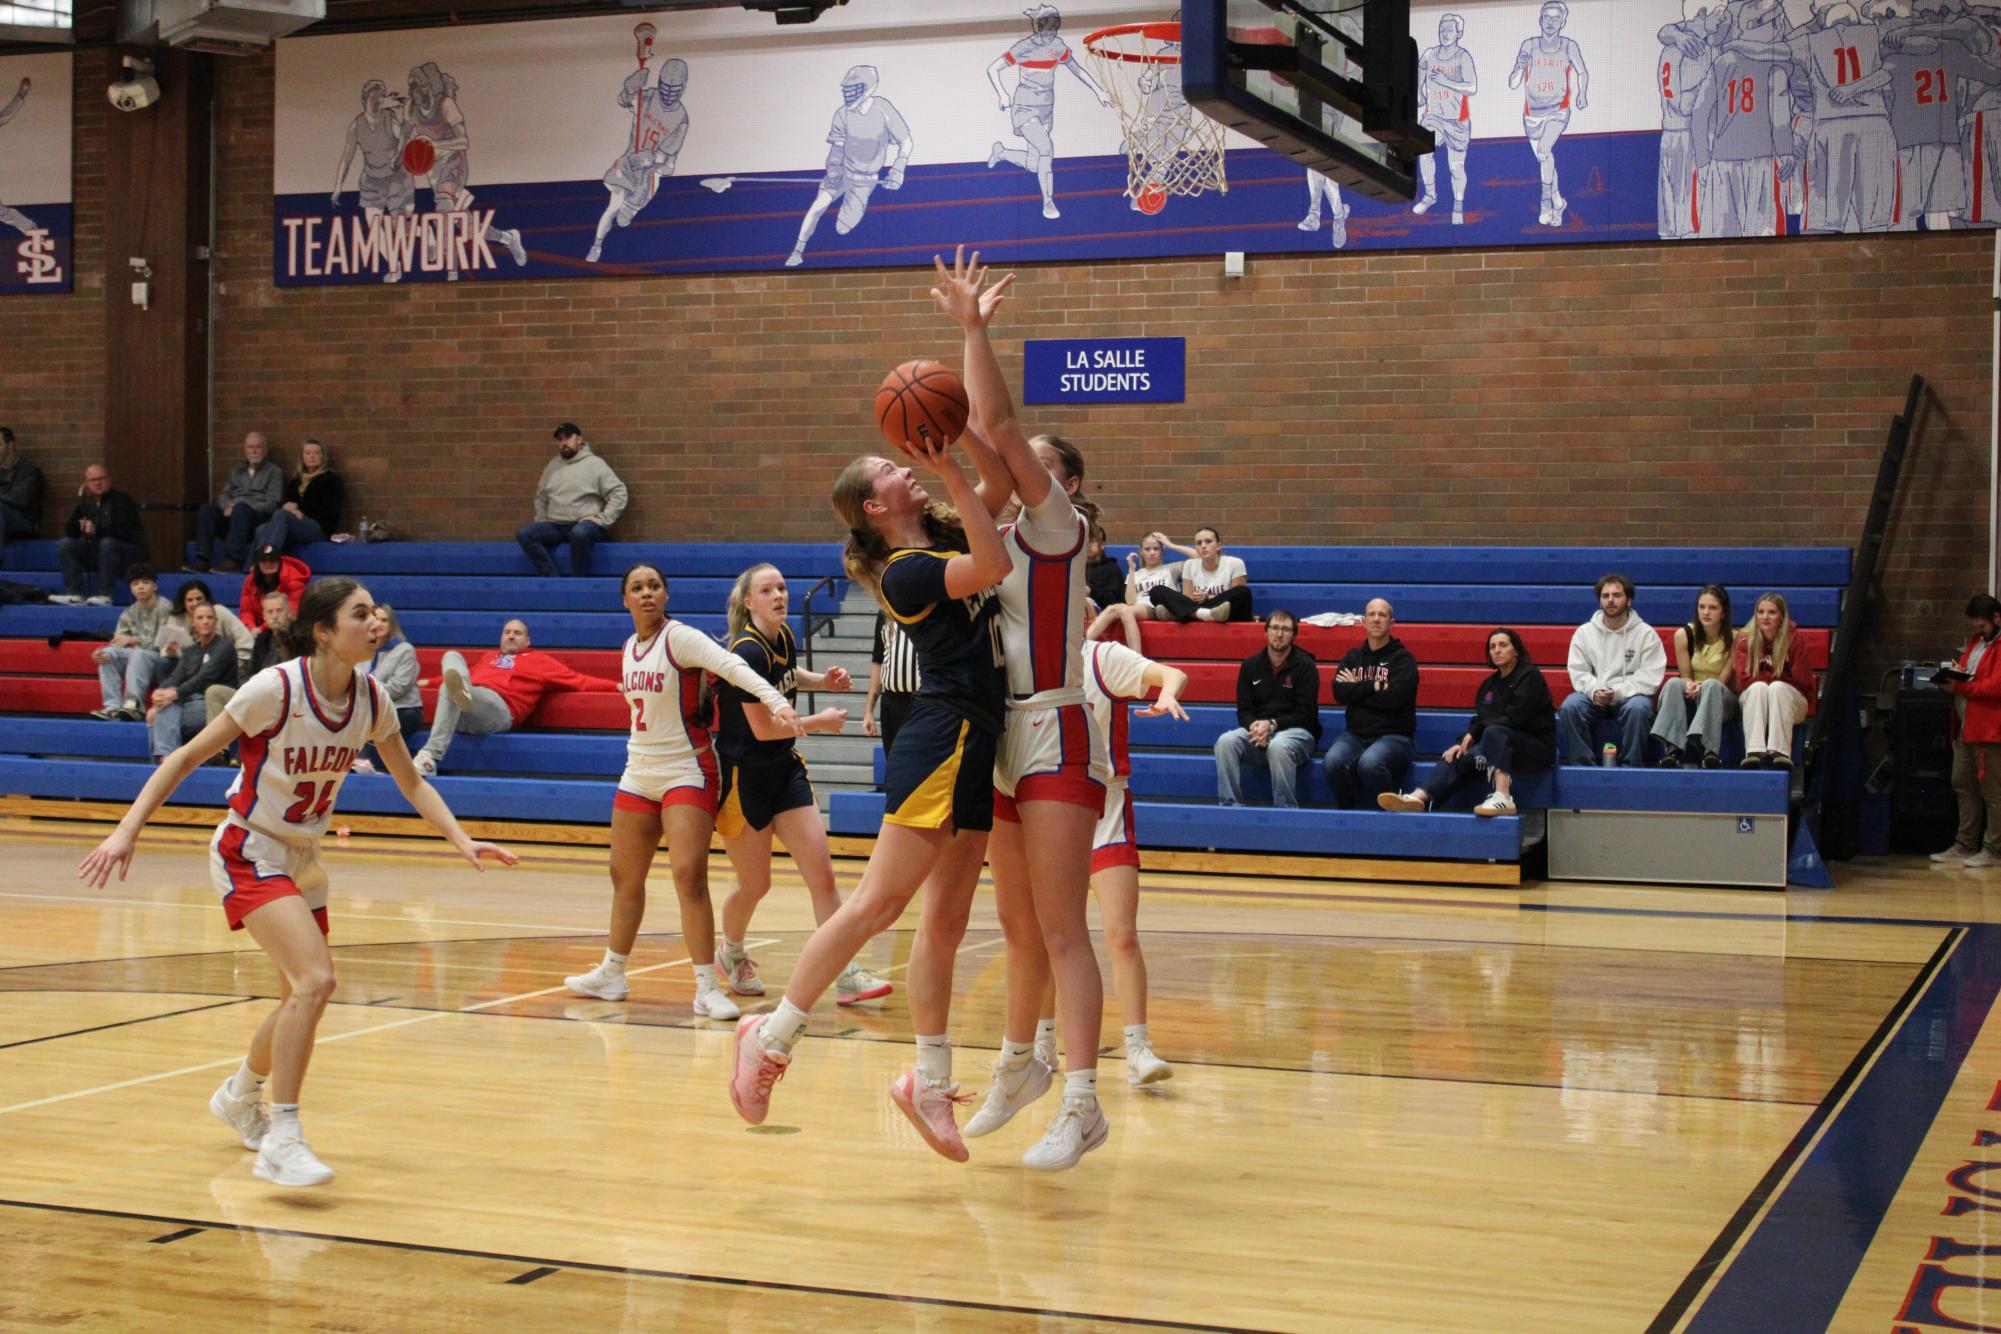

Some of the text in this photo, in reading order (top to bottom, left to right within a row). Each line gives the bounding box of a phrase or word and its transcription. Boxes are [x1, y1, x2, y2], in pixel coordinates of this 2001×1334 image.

[1662, 62, 1674, 99] 2
[1834, 46, 1861, 85] 11
[1726, 76, 1755, 115] 18
[1914, 67, 1948, 105] 21
[282, 209, 498, 277] TEAMWORK
[1066, 349, 1145, 369] LA SALLE
[1060, 372, 1151, 393] STUDENTS
[633, 698, 647, 732] 2
